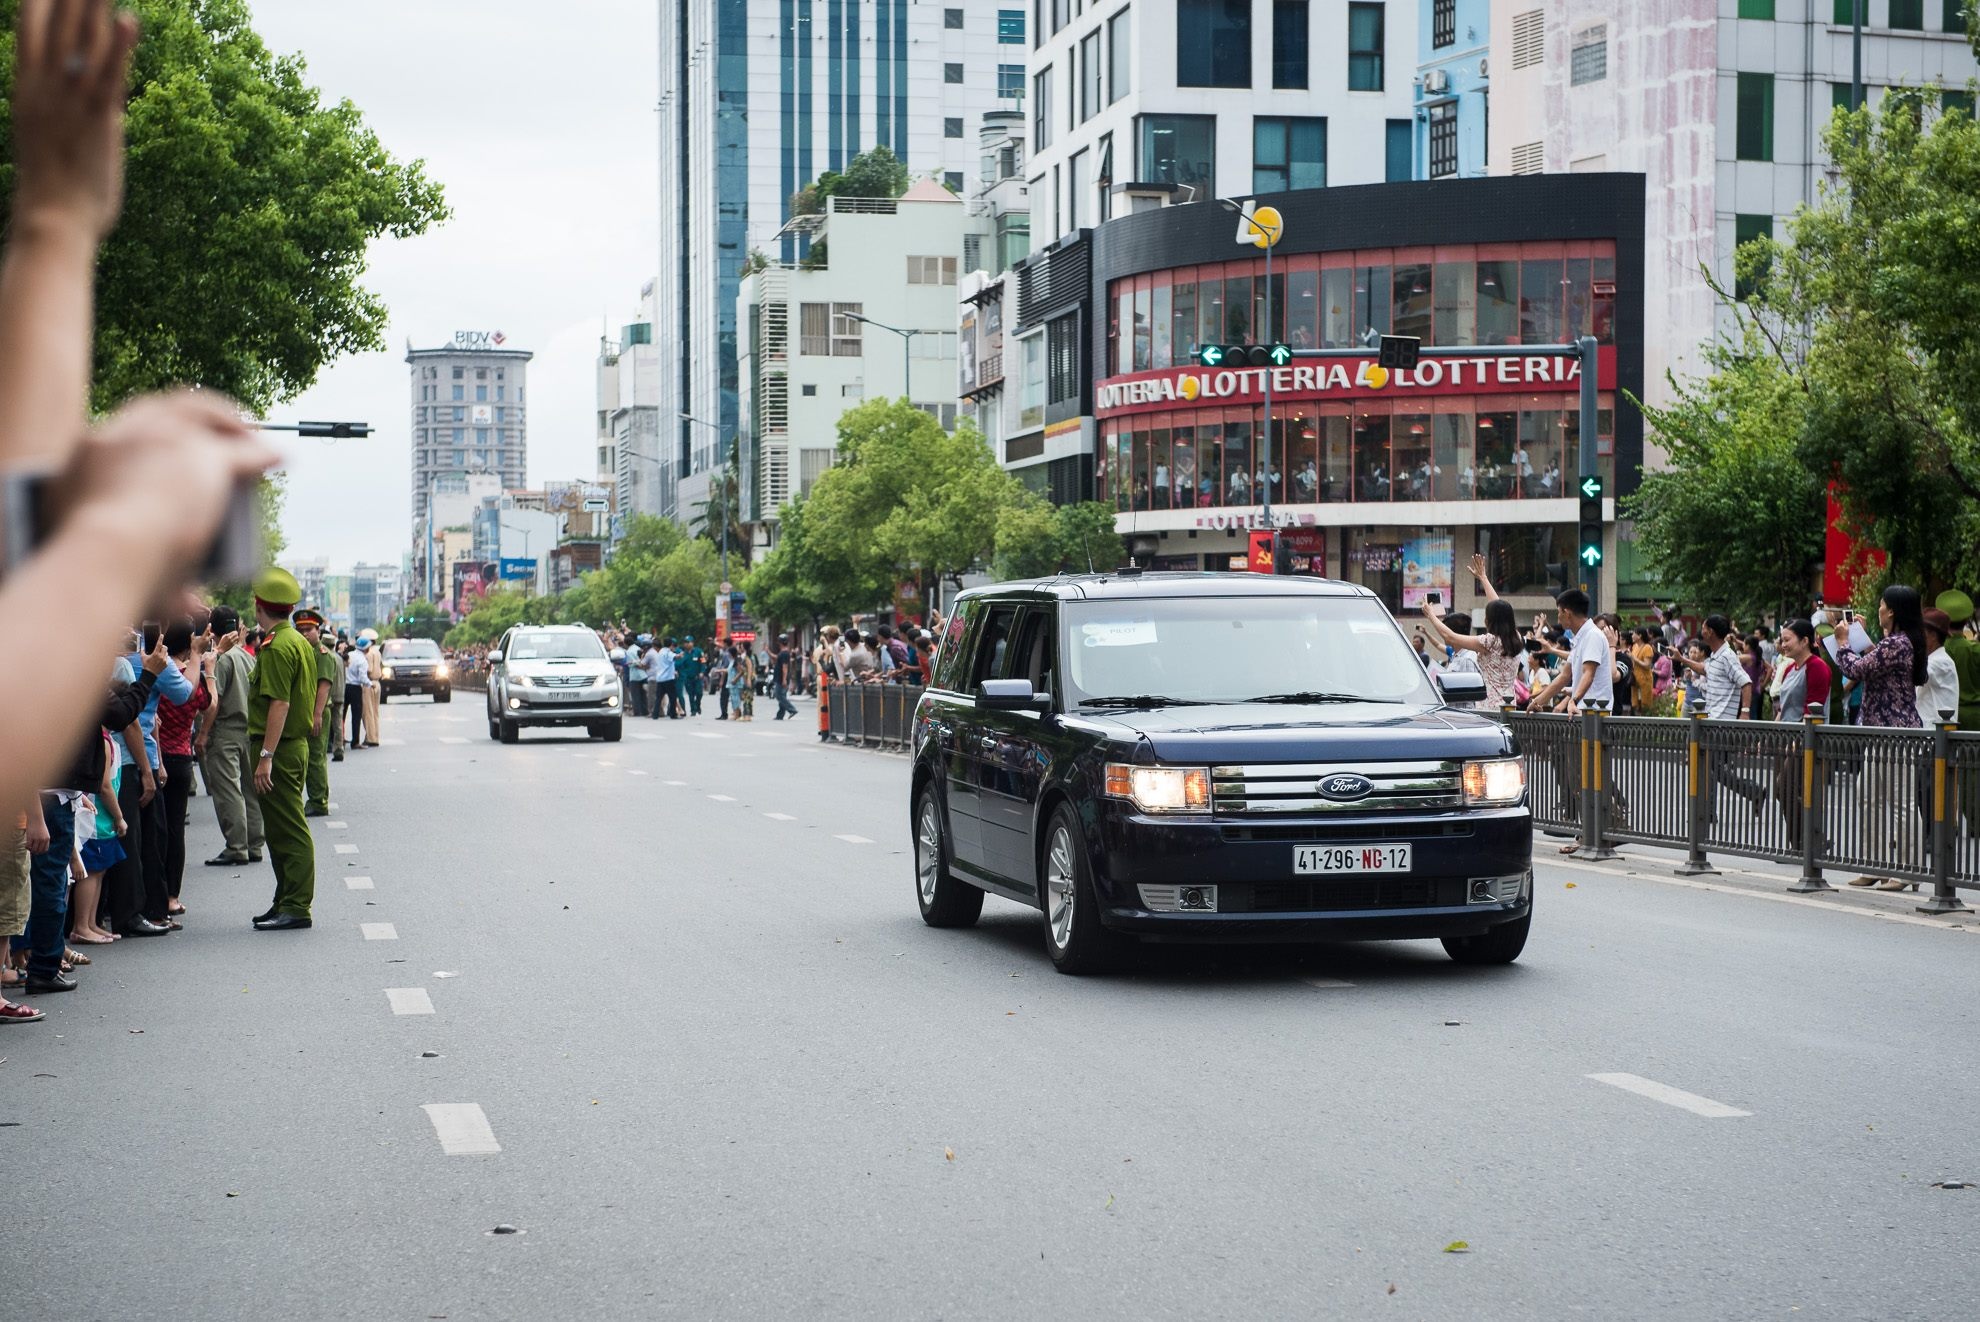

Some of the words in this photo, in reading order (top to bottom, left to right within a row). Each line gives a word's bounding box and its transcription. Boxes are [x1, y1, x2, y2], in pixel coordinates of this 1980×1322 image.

[455, 331, 489, 343] BIDV
[1097, 378, 1176, 408] LOTTERIA
[1201, 364, 1351, 398] LOTTERIA
[1330, 778, 1361, 792] Ford
[1298, 848, 1407, 871] 41-296-NG-12
